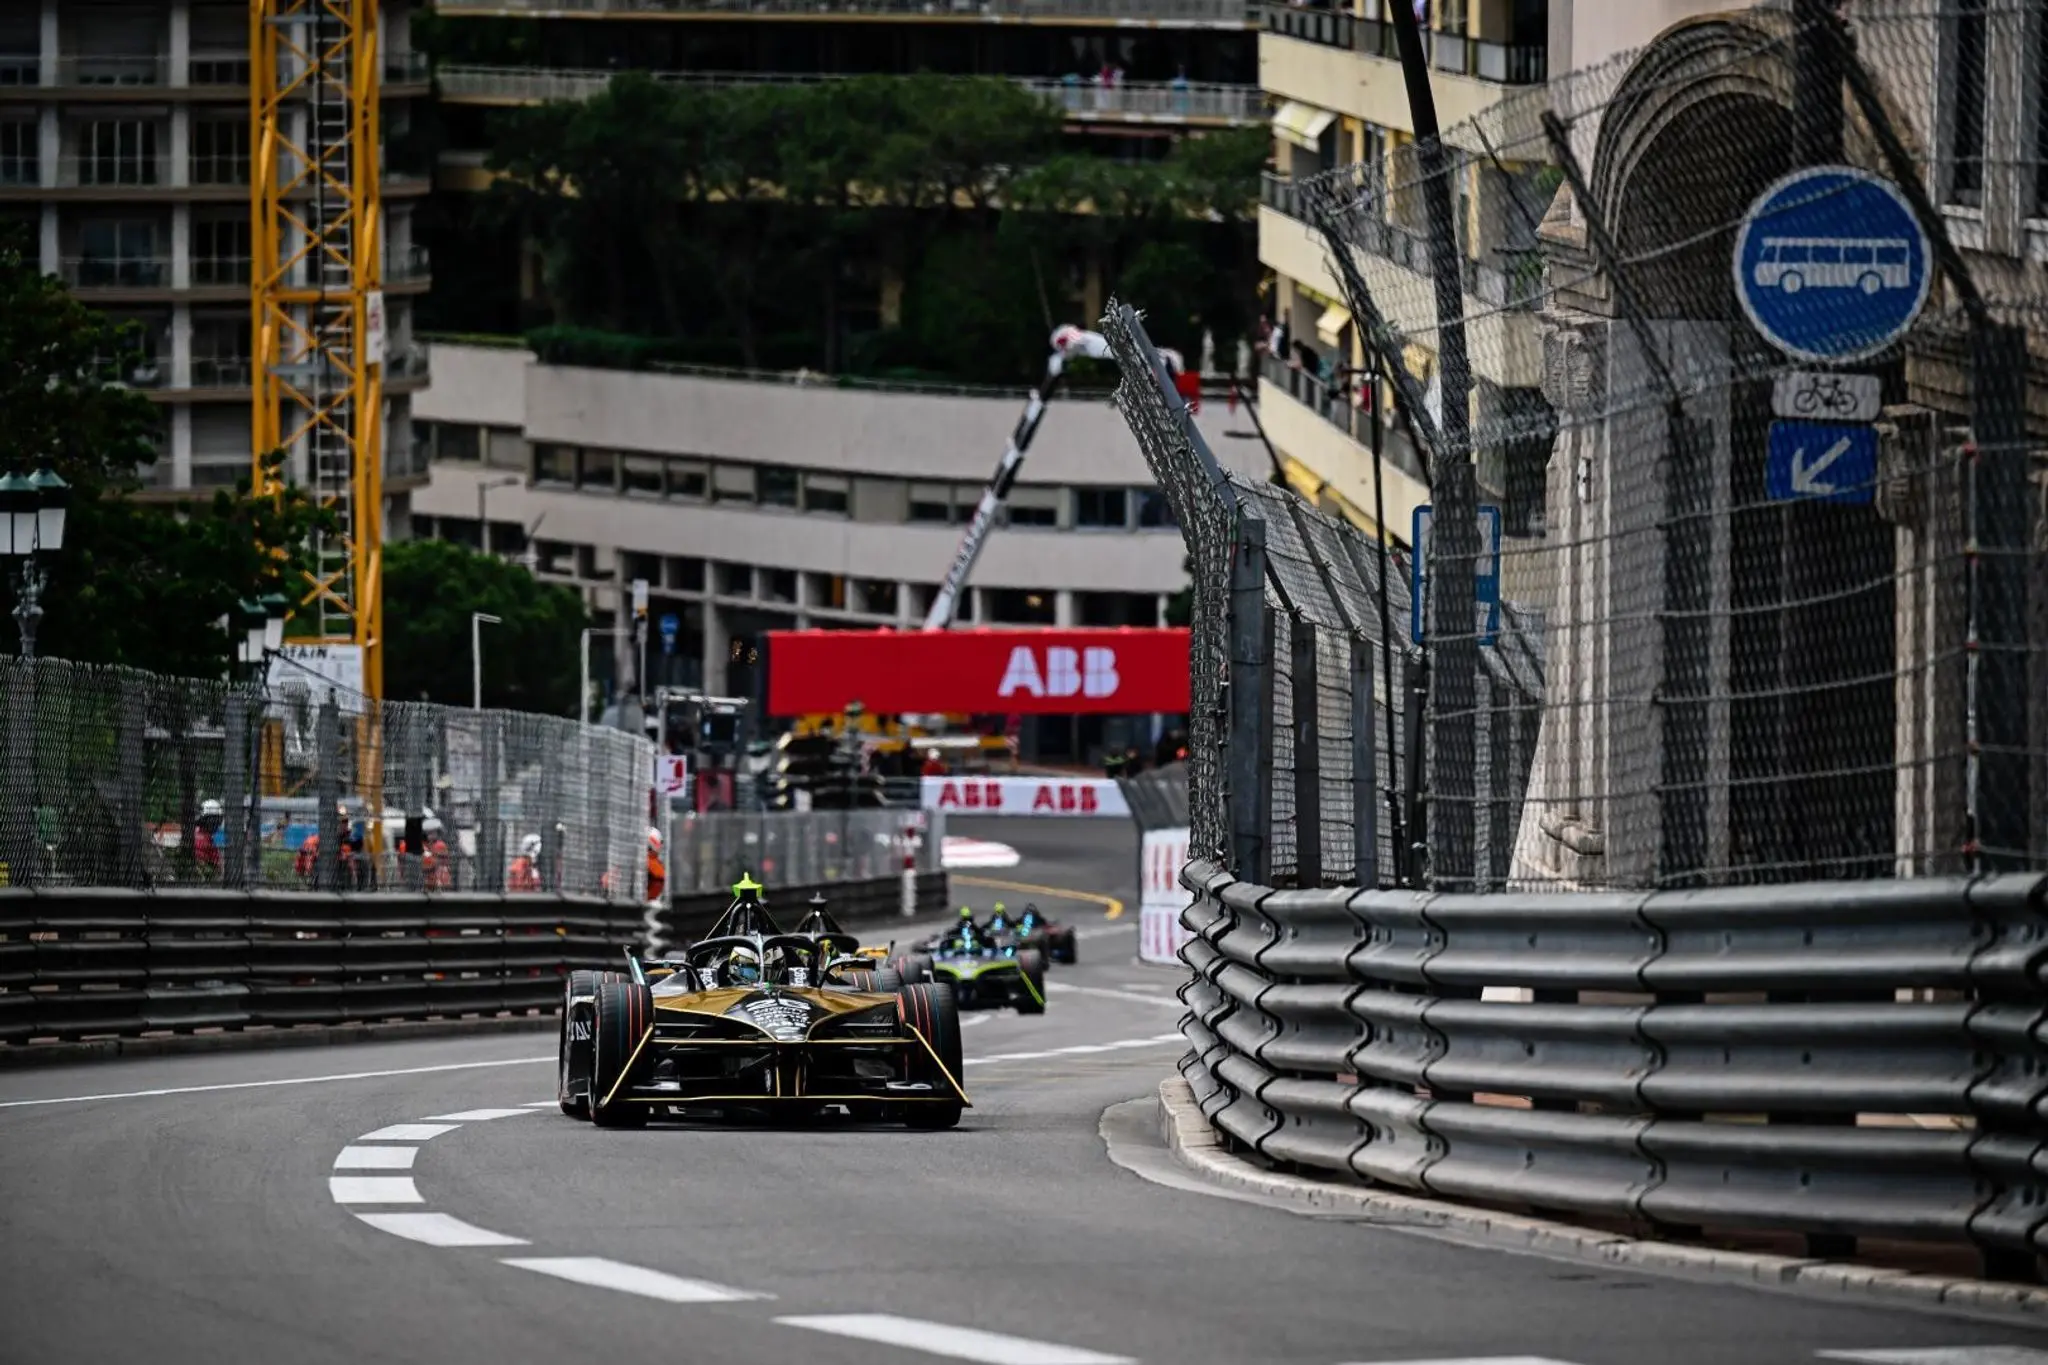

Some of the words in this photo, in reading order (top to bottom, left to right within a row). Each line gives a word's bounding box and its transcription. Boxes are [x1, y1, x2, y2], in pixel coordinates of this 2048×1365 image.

[998, 646, 1120, 698] ABB
[939, 782, 1004, 808] ABB
[1033, 785, 1099, 812] ABB
